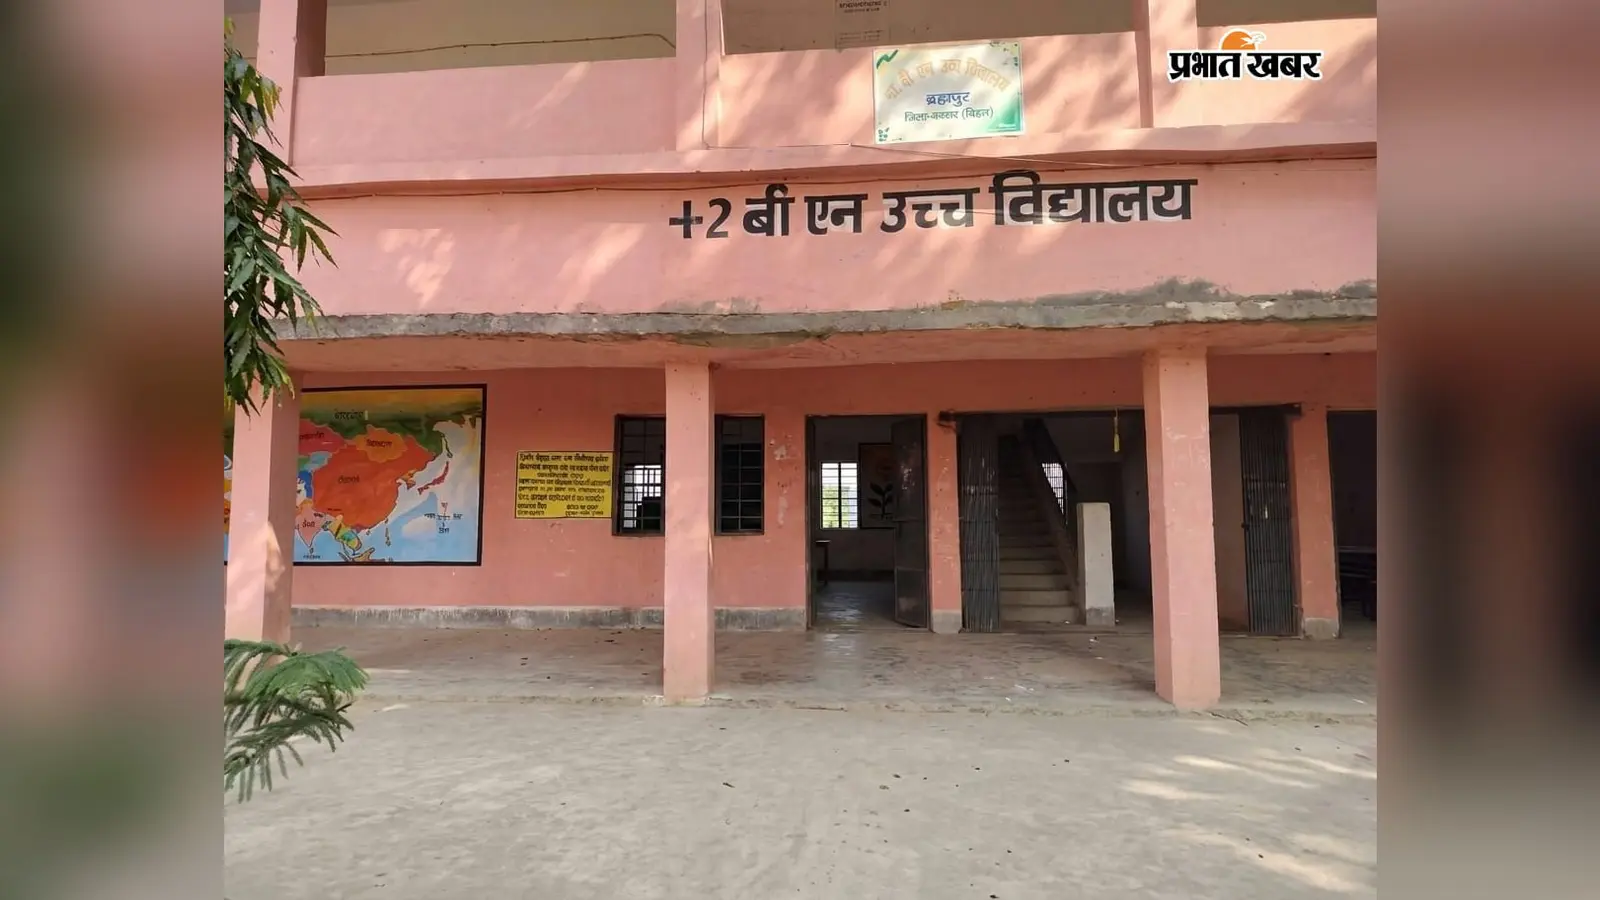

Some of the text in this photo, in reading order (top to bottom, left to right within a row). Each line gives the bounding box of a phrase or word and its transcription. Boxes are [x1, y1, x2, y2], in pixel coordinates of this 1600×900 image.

[668, 169, 1199, 239] +2 बी एन उच्च विद्यालय
